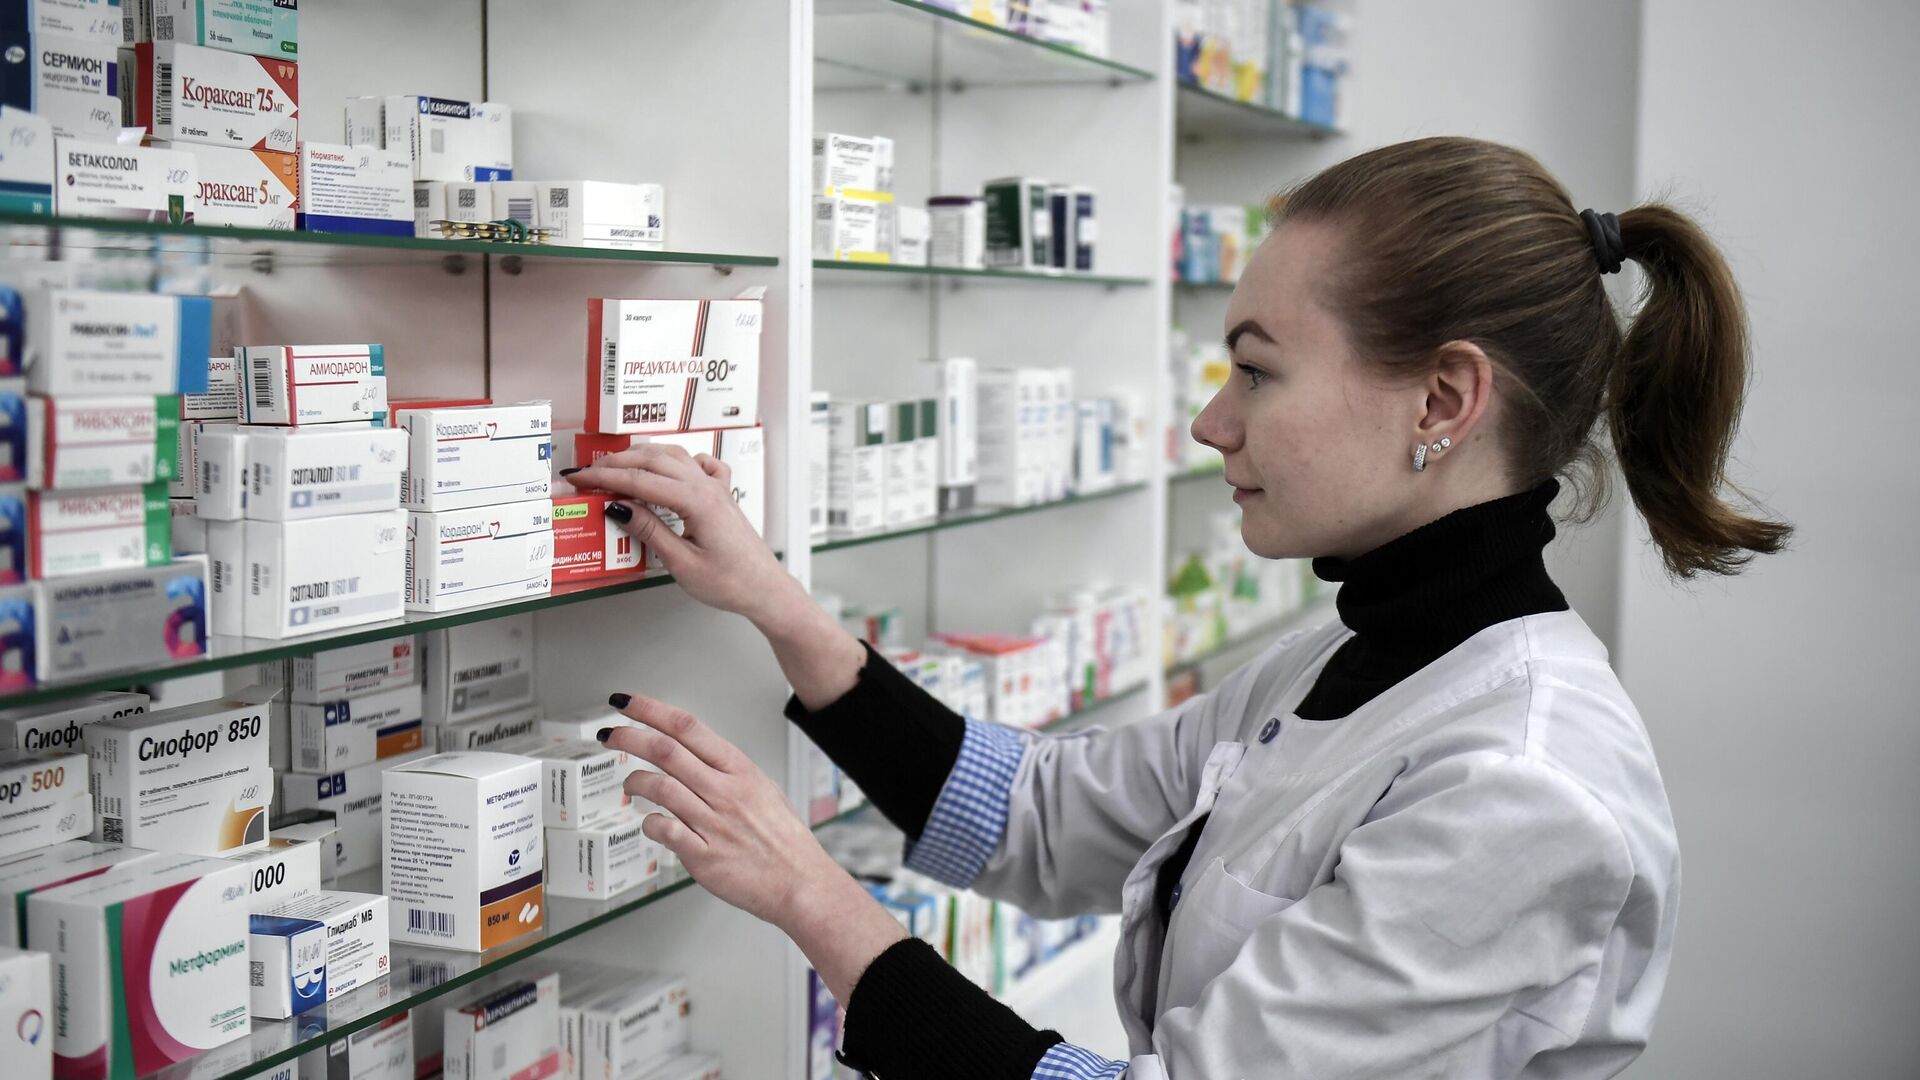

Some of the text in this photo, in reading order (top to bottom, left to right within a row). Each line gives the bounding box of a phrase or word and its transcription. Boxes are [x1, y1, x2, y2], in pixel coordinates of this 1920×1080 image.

[42, 51, 102, 74] СЕРМИОН
[81, 75, 90, 86] 10
[91, 79, 101, 88] мг
[181, 127, 188, 135] 56
[68, 152, 138, 172] БЕТАКСОЛОЛ
[259, 180, 269, 205] 5
[625, 313, 652, 323] 30 капсул
[309, 361, 368, 377] АМИОДАРОН
[687, 360, 704, 374] ОД
[705, 359, 729, 382] 80
[531, 419, 539, 429] 200
[290, 466, 334, 485] СОТАЛОЛ
[525, 484, 542, 494] SANOFI
[554, 507, 565, 517] 60
[532, 516, 542, 526] 200
[543, 517, 550, 525] мг
[591, 550, 602, 560] МВ
[404, 549, 412, 603] Кордарон
[290, 580, 330, 603] СОТАЛОЛ
[526, 580, 543, 590] SANOFI
[345, 665, 389, 682] ГЛИМЕПИРИД
[228, 715, 261, 742] 850
[581, 759, 615, 778] Манинил
[32, 766, 64, 792] 500
[486, 781, 538, 806] МЕТФОРМИН КАНОН
[608, 827, 641, 848] Манинил
[422, 852, 453, 861] температуре
[361, 909, 373, 924] МВ
[487, 911, 510, 927] 850 мг
[169, 940, 246, 978] Метформин
[378, 955, 388, 968] 60
[335, 978, 357, 993] акрихин
[58, 963, 68, 1038] Метформин
[486, 988, 538, 1027] ВЕРОШПИРОН
